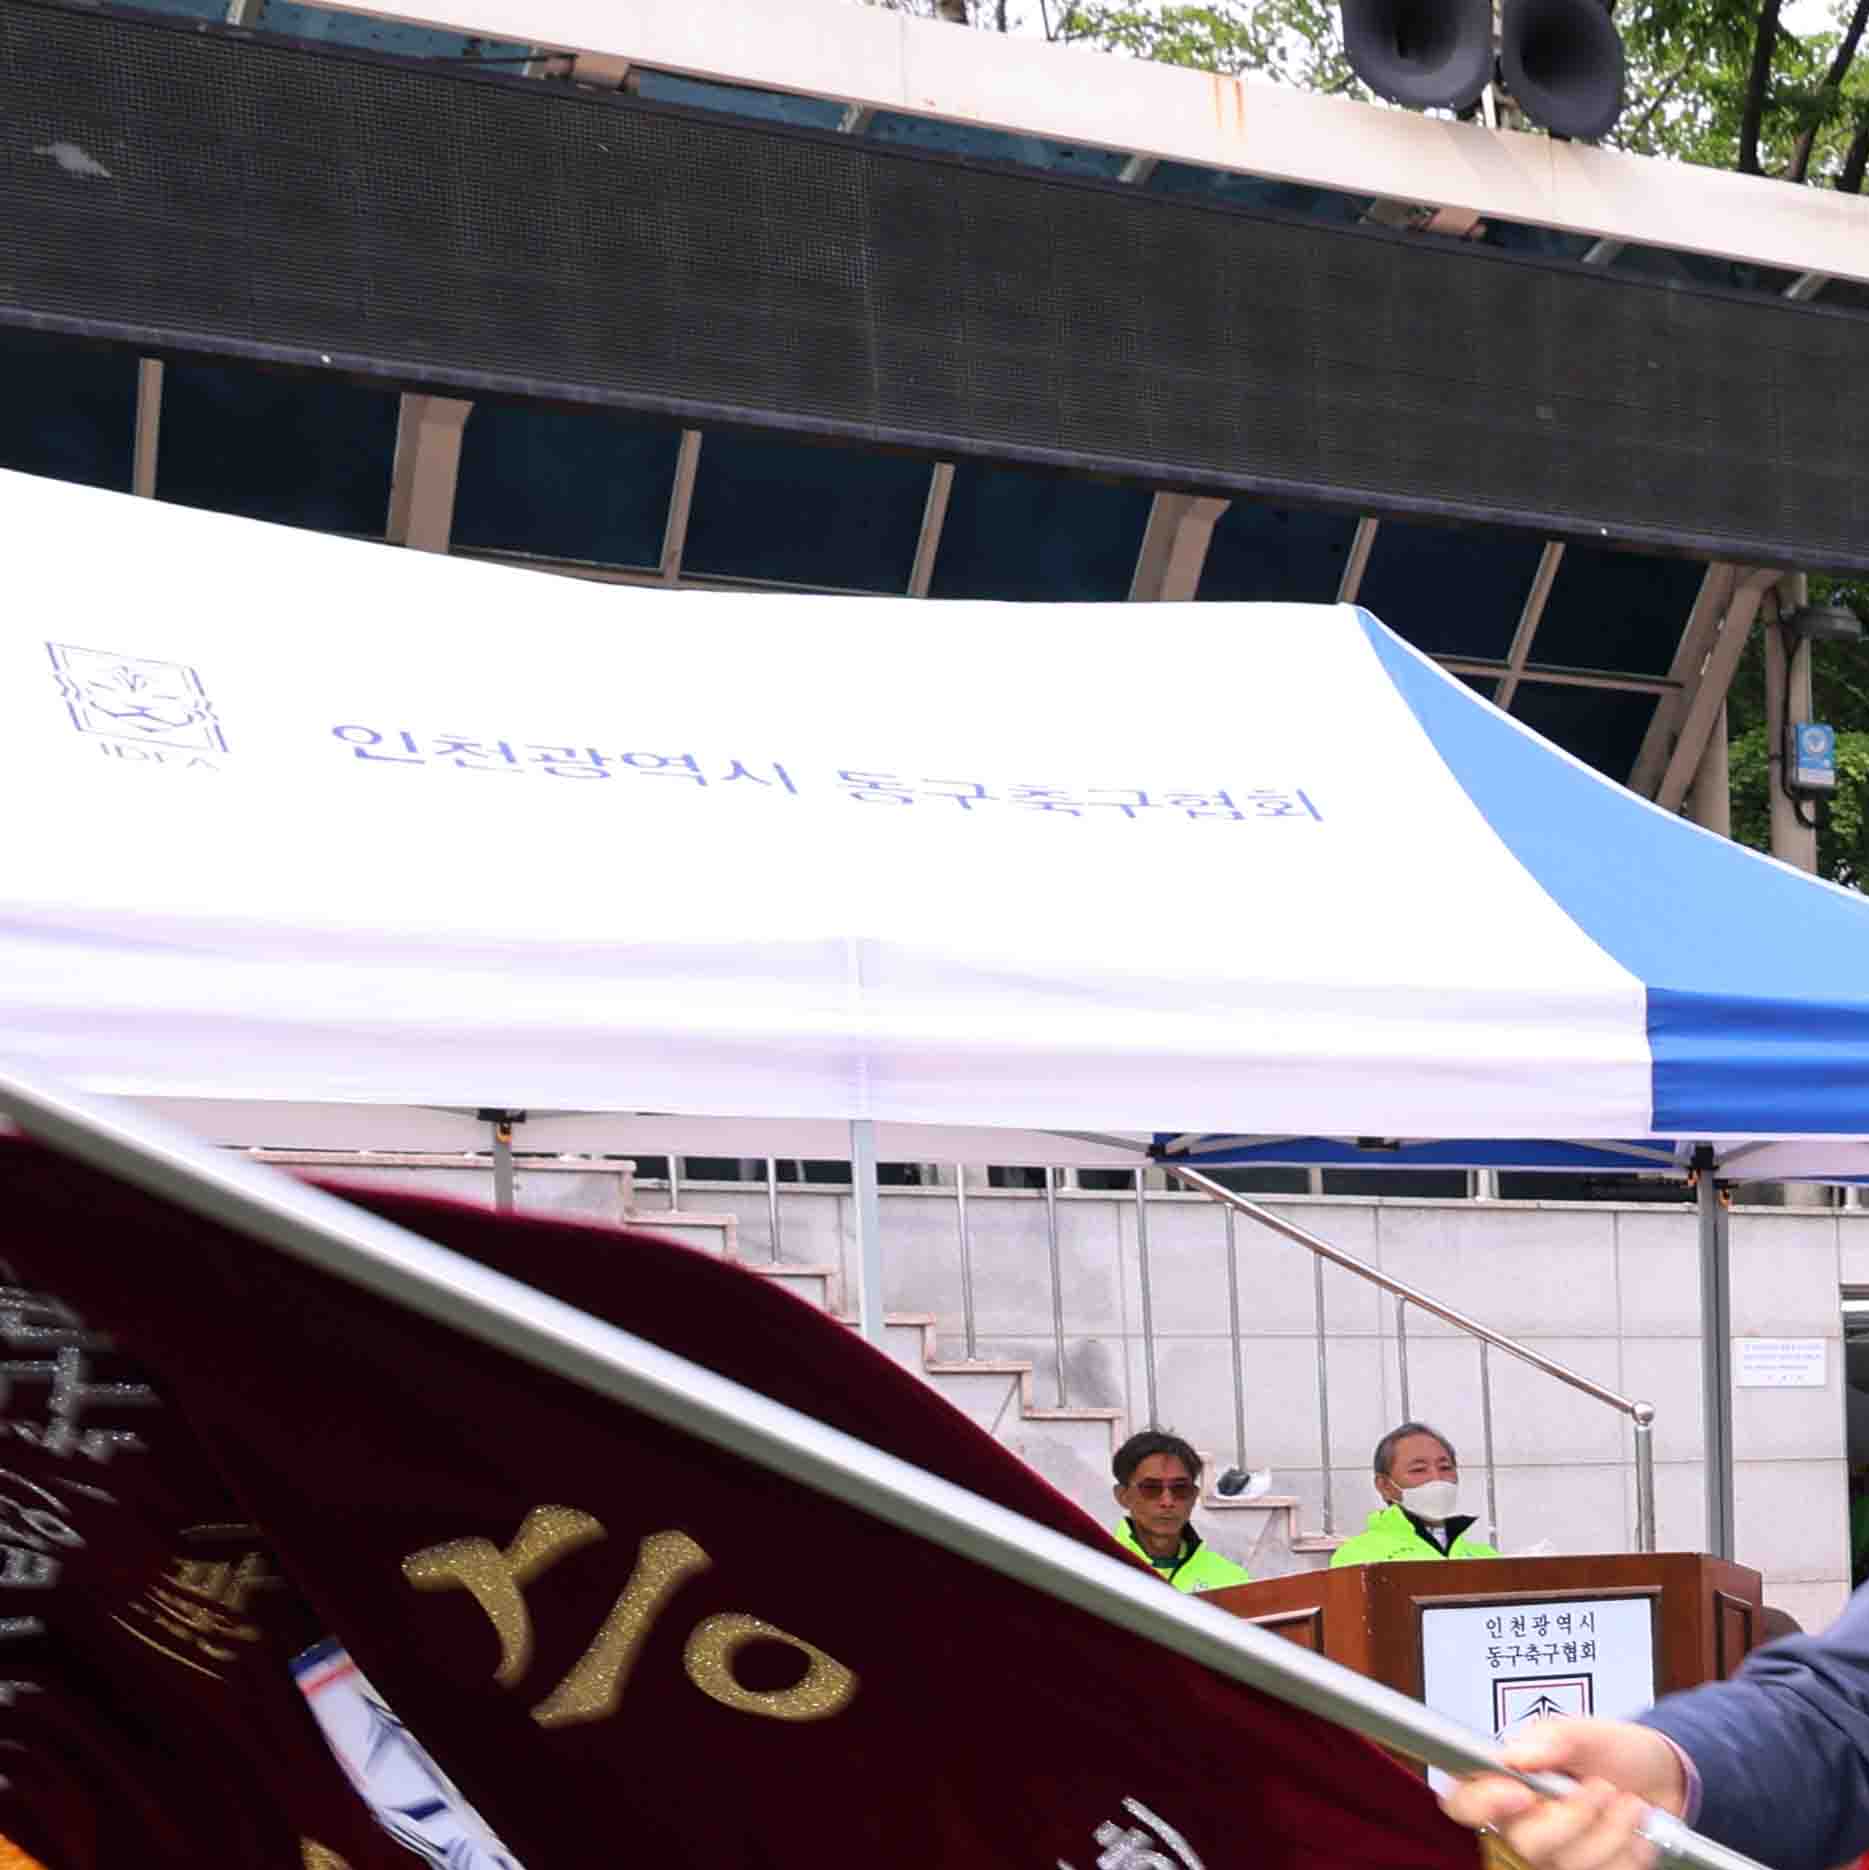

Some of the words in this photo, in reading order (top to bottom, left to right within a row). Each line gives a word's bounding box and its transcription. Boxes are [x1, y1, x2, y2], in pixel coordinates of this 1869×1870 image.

[328, 719, 800, 796] 인천광역시
[832, 764, 1326, 822] 동구축구협회
[1485, 1611, 1596, 1639] 인천광역시
[1487, 1641, 1597, 1668] 동구축구협회
